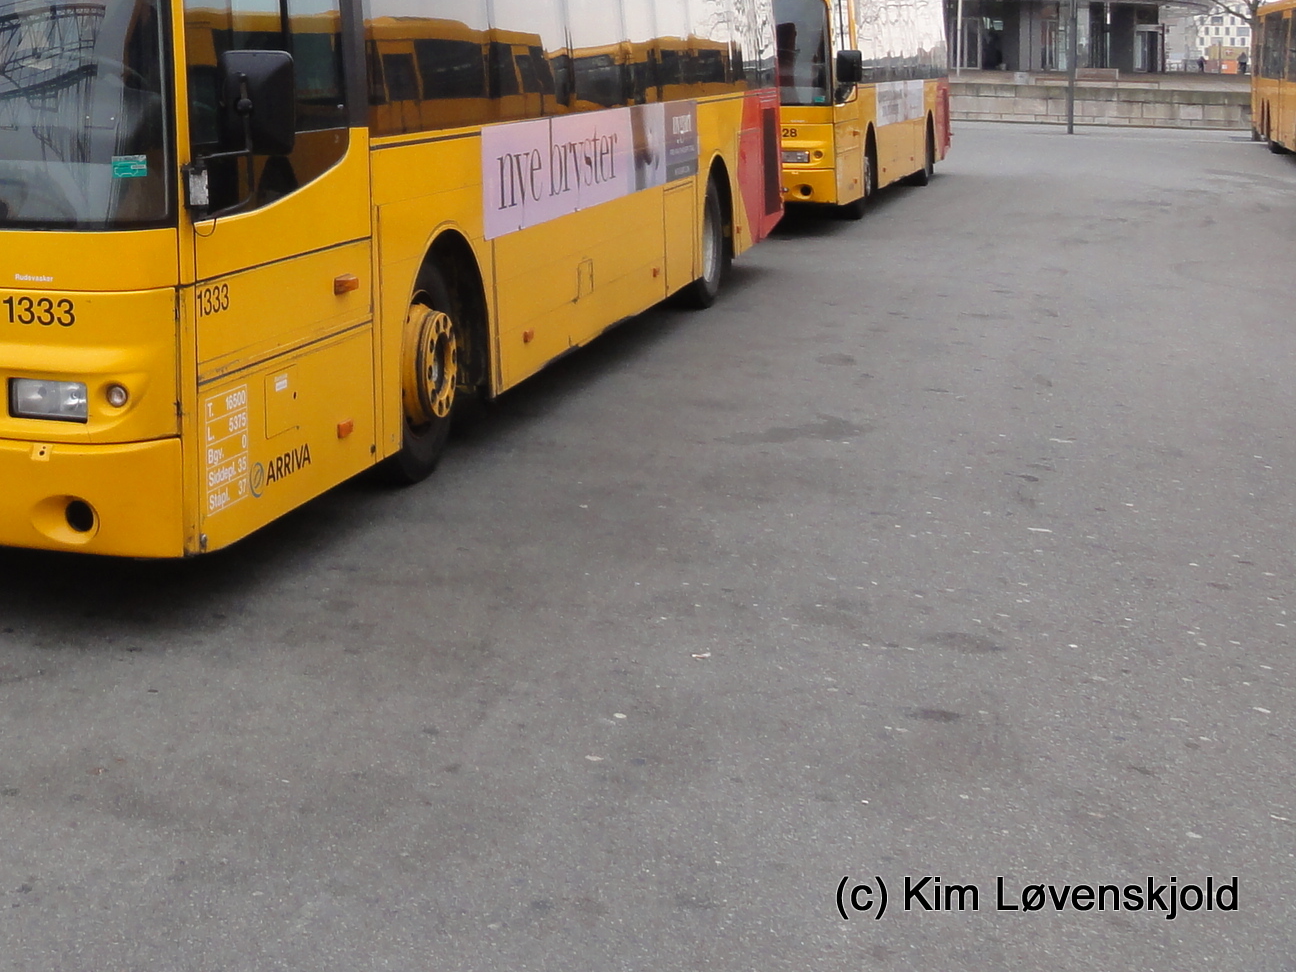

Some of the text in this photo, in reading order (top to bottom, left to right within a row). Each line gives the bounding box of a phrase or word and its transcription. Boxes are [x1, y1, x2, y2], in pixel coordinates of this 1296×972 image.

[497, 117, 618, 228] nye bryster
[2, 296, 76, 327] 1333
[197, 283, 229, 317] 1333
[207, 402, 214, 417] T.
[207, 412, 247, 441] L. 5375
[237, 456, 247, 473] 35
[266, 443, 311, 486] ARRIVA
[238, 478, 247, 495] 37
